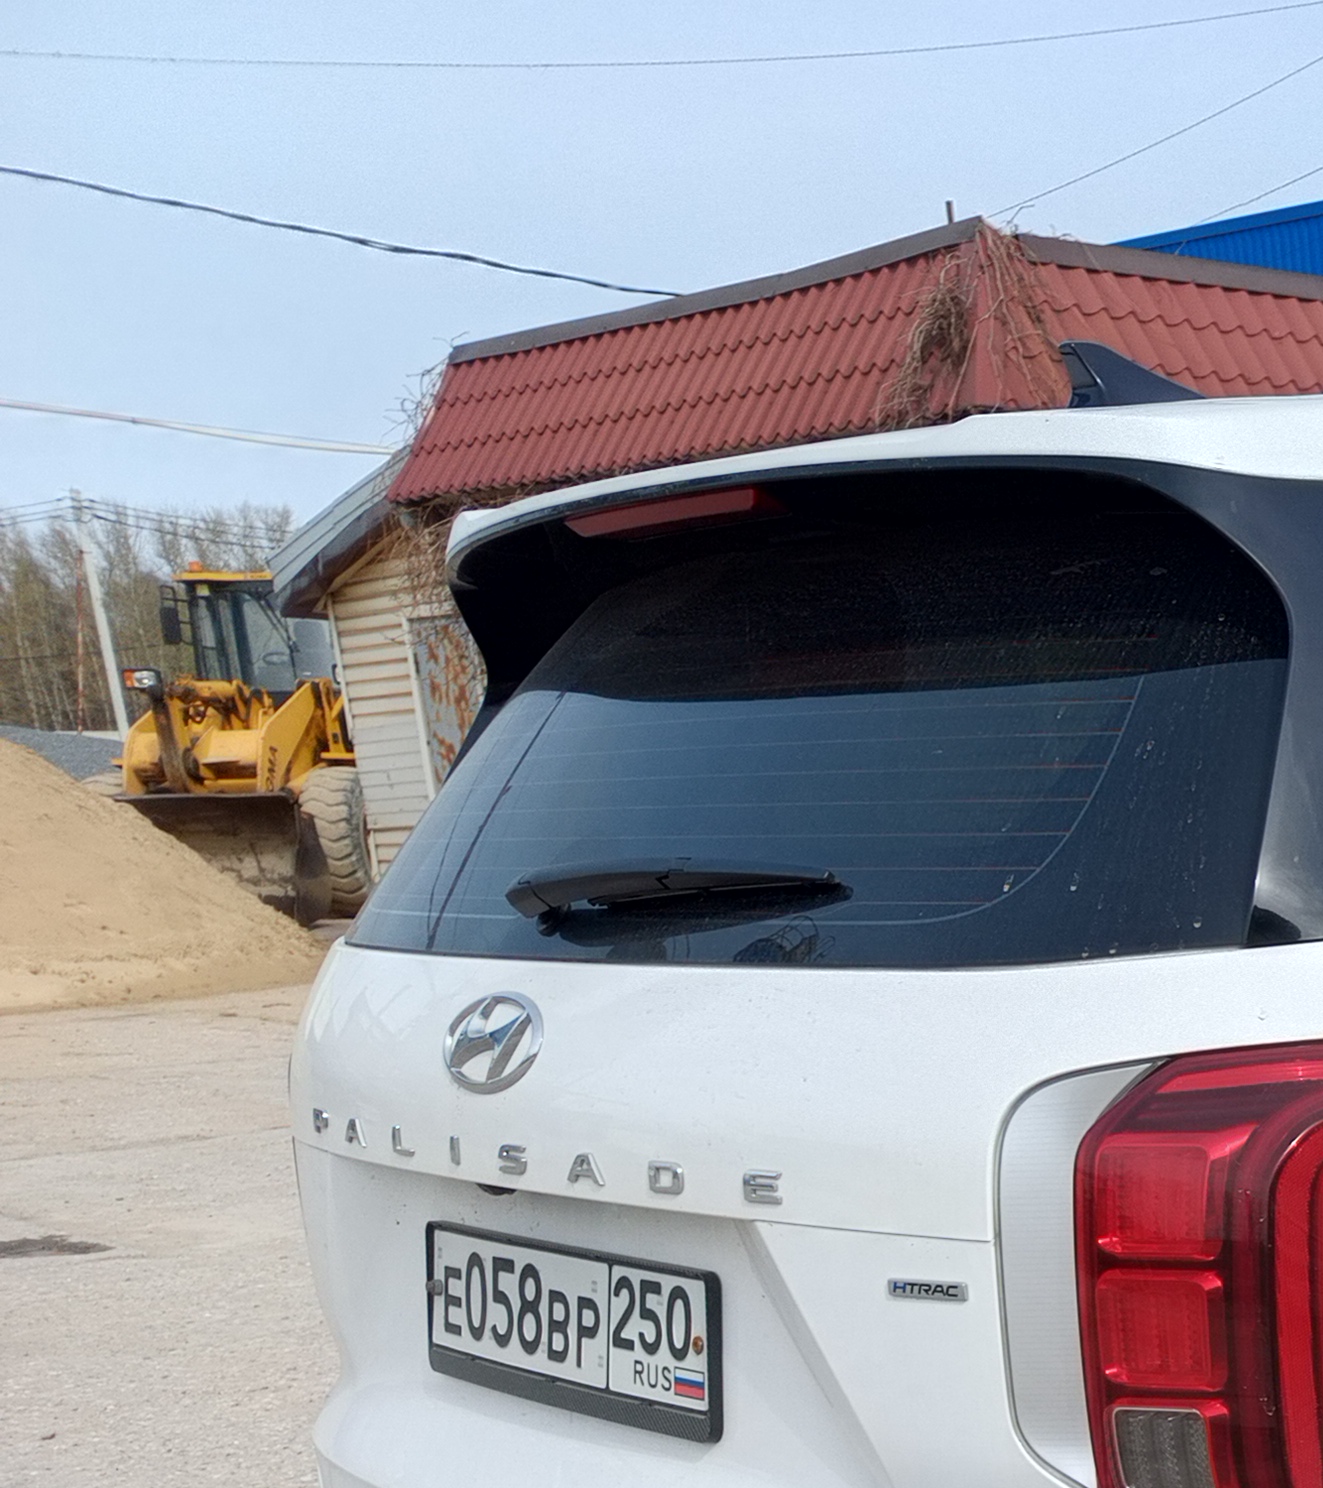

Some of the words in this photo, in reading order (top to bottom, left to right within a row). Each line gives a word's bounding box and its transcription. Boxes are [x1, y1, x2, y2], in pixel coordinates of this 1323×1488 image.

[312, 1106, 784, 1205] PALISADE
[443, 1251, 601, 1369] Е058ВР
[611, 1274, 693, 1362] 250
[892, 1281, 959, 1298] HTRAC
[633, 1359, 673, 1392] RUS
